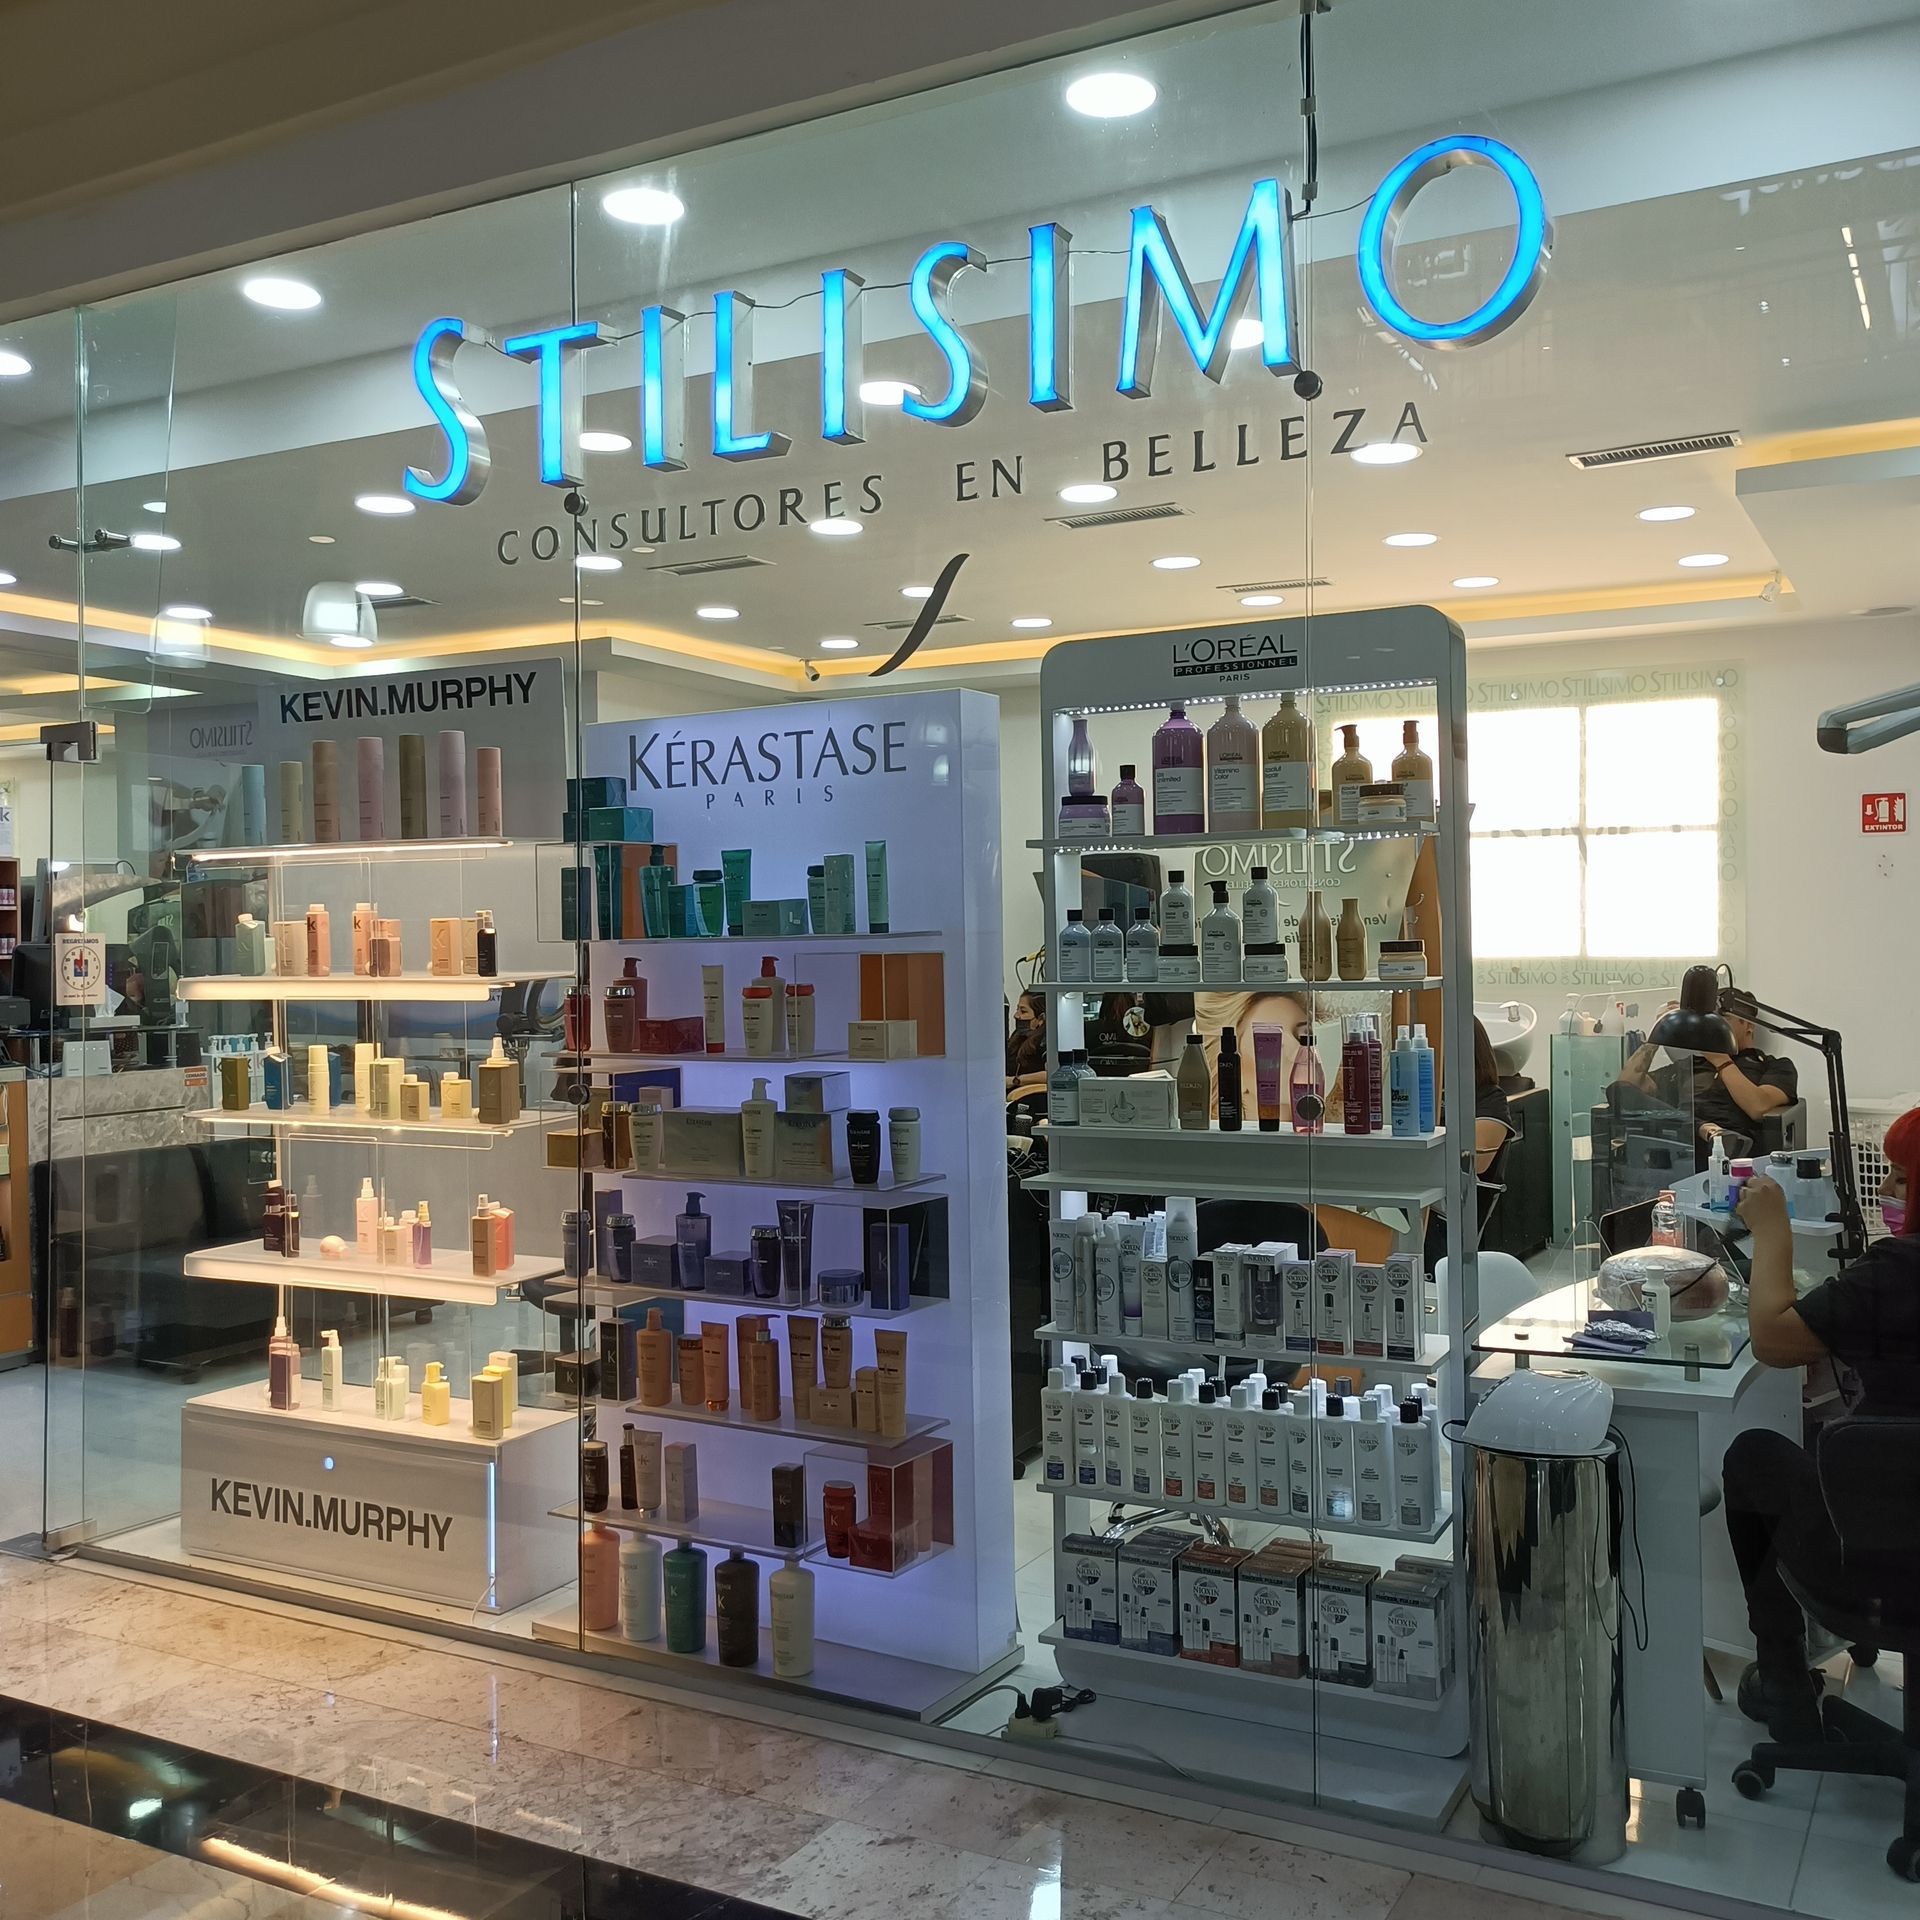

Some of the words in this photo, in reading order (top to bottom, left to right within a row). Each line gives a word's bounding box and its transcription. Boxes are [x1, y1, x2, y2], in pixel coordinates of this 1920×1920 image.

[403, 134, 1552, 504] STILISIMO
[498, 473, 885, 565] CONSULTORES
[956, 455, 1024, 502] EN
[1102, 401, 1429, 483] BELLEZA
[1172, 633, 1298, 664] L'ORÉAL
[1175, 657, 1297, 676] PROFESSIONNEL
[1219, 673, 1250, 683] PARIS
[1478, 679, 1559, 704] STILISIMO
[1561, 674, 1647, 698] STILISIMO
[1650, 668, 1738, 693] STILISIMO
[280, 671, 537, 724] KEVIN.MURPHY
[628, 720, 908, 791] KÉRASTASE
[705, 784, 835, 810] PARIS
[1487, 969, 1557, 985] STILISIMO
[1571, 969, 1645, 985] STILISIMO
[210, 1477, 454, 1553] KEVIN.MURPHY
[1076, 1567, 1102, 1577] NIOXIN
[1132, 1575, 1158, 1587] NIOXIN
[1193, 1586, 1220, 1597] NIOXIN
[1254, 1597, 1282, 1608] NIOXIN
[1321, 1604, 1350, 1616] NIOXIN
[1387, 1616, 1418, 1629] NIOXIN
